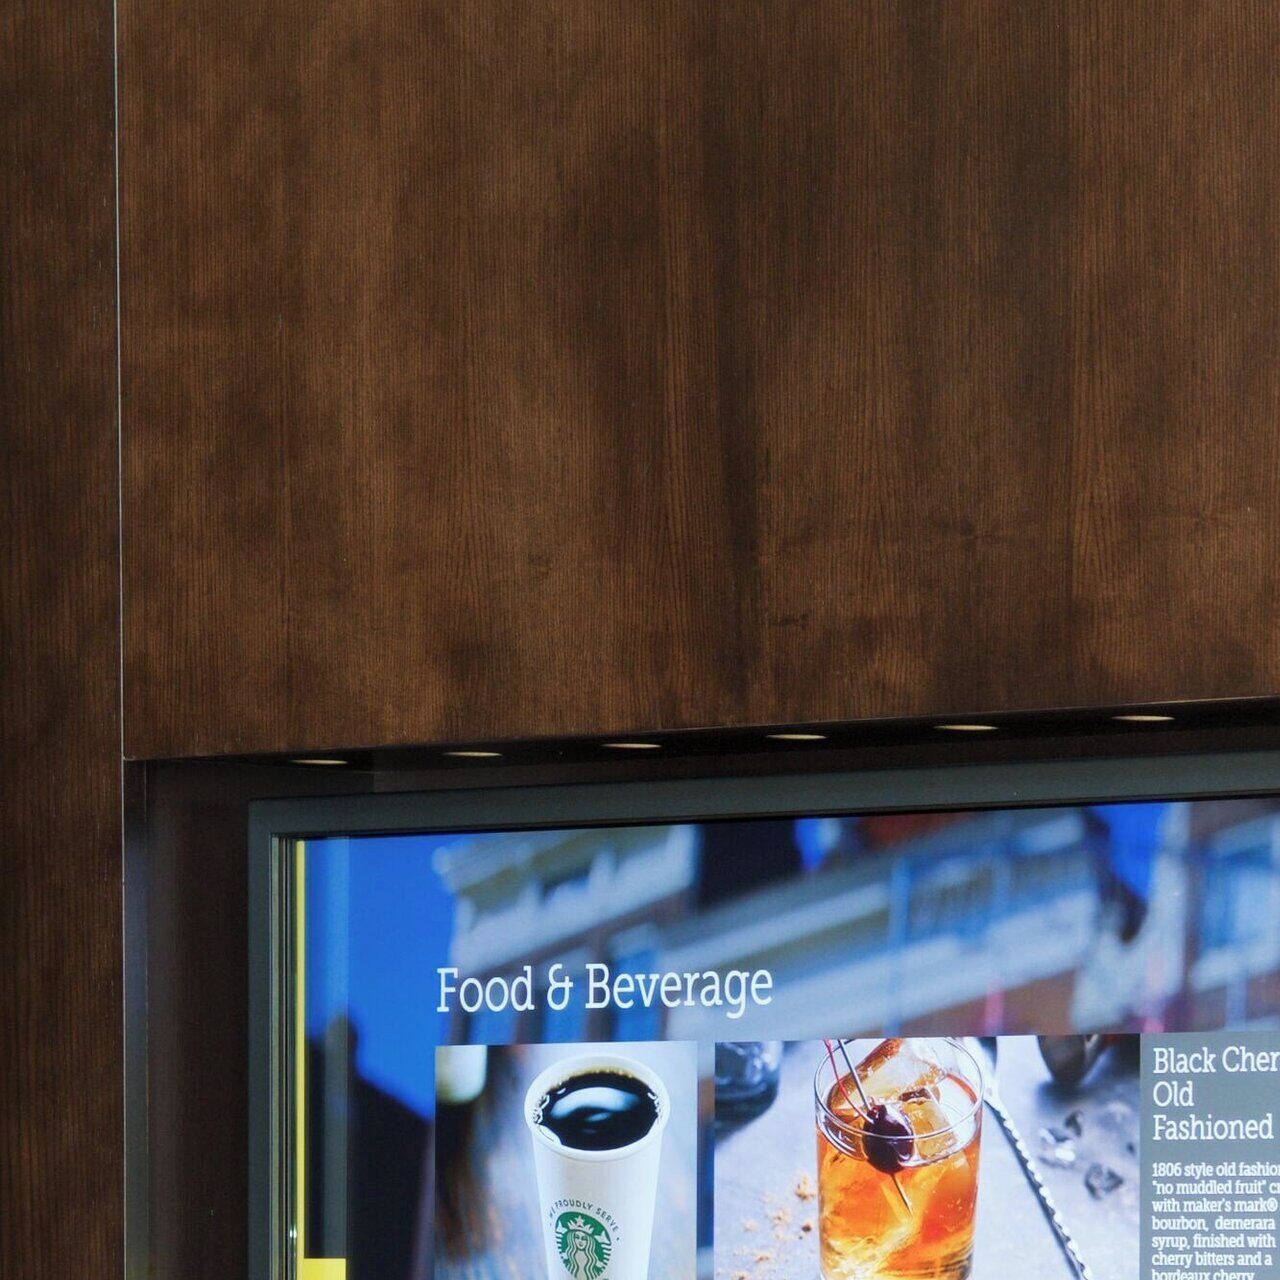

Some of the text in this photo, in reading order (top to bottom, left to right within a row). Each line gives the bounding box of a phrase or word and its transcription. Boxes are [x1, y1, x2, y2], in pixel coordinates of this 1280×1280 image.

[436, 963, 773, 1019] Food & Beverage
[1153, 1047, 1216, 1074] Black
[1153, 1081, 1194, 1107] Old
[1153, 1113, 1274, 1140] Fashioned
[1152, 1163, 1182, 1177] 1806
[1184, 1162, 1213, 1180] style
[1216, 1162, 1236, 1176] old
[1177, 1180, 1232, 1195] muddled
[1152, 1198, 1278, 1212] with maker's mark®
[555, 1199, 620, 1232] PROUDLY SERVE
[1152, 1216, 1276, 1231] bourbon, demerara
[1152, 1234, 1276, 1250] syrup, finished with
[1152, 1252, 1272, 1268] cherry bitters and a
